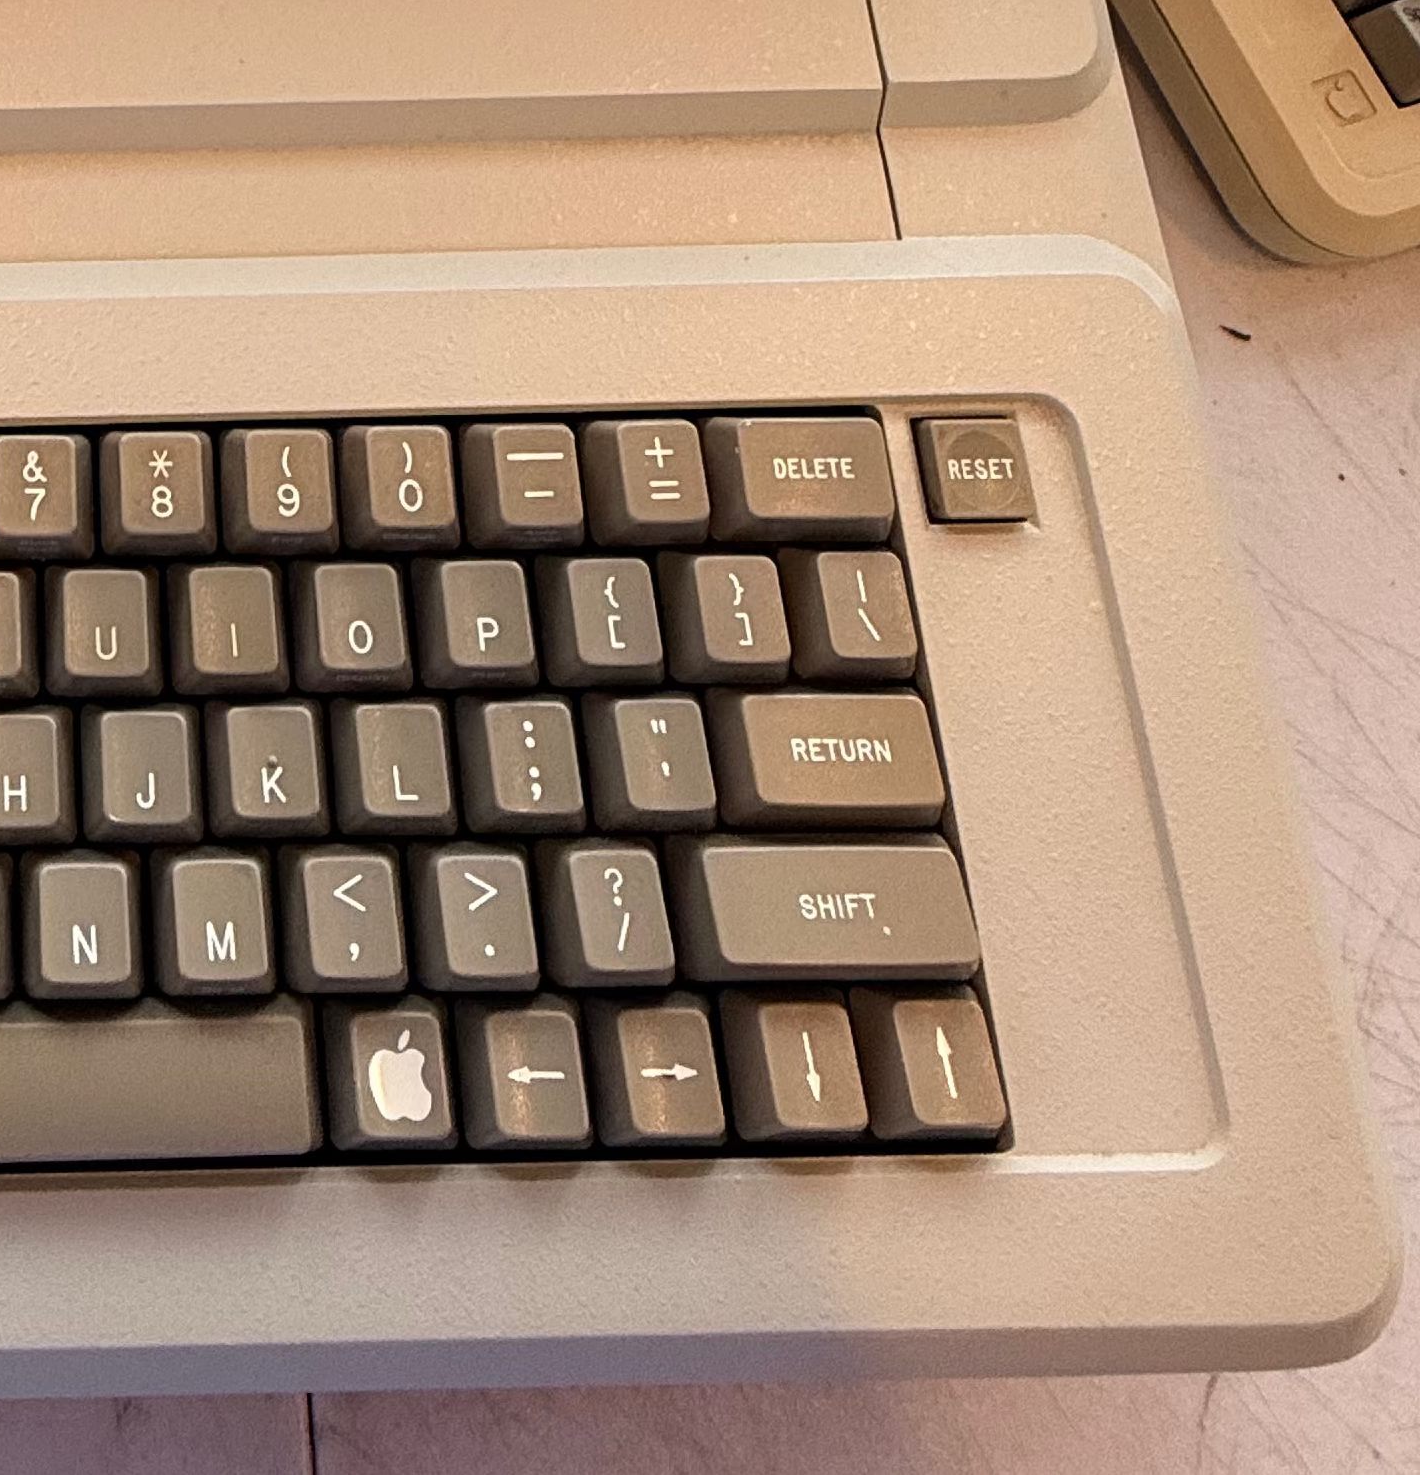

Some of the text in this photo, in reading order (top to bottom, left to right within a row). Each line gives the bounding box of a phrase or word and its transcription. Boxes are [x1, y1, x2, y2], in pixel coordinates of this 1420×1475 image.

[22, 450, 48, 483] &
[281, 446, 292, 478] (
[402, 441, 413, 474] )
[644, 436, 674, 468] +
[772, 457, 855, 480] DELETE
[947, 458, 1014, 480] RESET
[24, 487, 46, 521] 7
[151, 484, 174, 518] 8
[276, 483, 300, 518] 9
[398, 478, 424, 513] 0
[603, 576, 620, 609] {
[728, 572, 745, 606] }
[95, 626, 118, 661] U
[230, 622, 239, 658] I
[348, 620, 374, 655] O
[476, 616, 500, 652] P
[607, 614, 626, 649] [
[734, 612, 754, 646] ]
[790, 737, 892, 763] RETURN
[3, 774, 28, 812] H
[136, 772, 156, 810] J
[260, 766, 287, 804] K
[392, 764, 419, 801] L
[333, 874, 366, 912] <
[464, 872, 498, 912] >
[604, 867, 624, 907] ?
[798, 892, 876, 920] SHIFT
[72, 924, 98, 965] N
[205, 920, 237, 962] M
[617, 912, 630, 952] /
